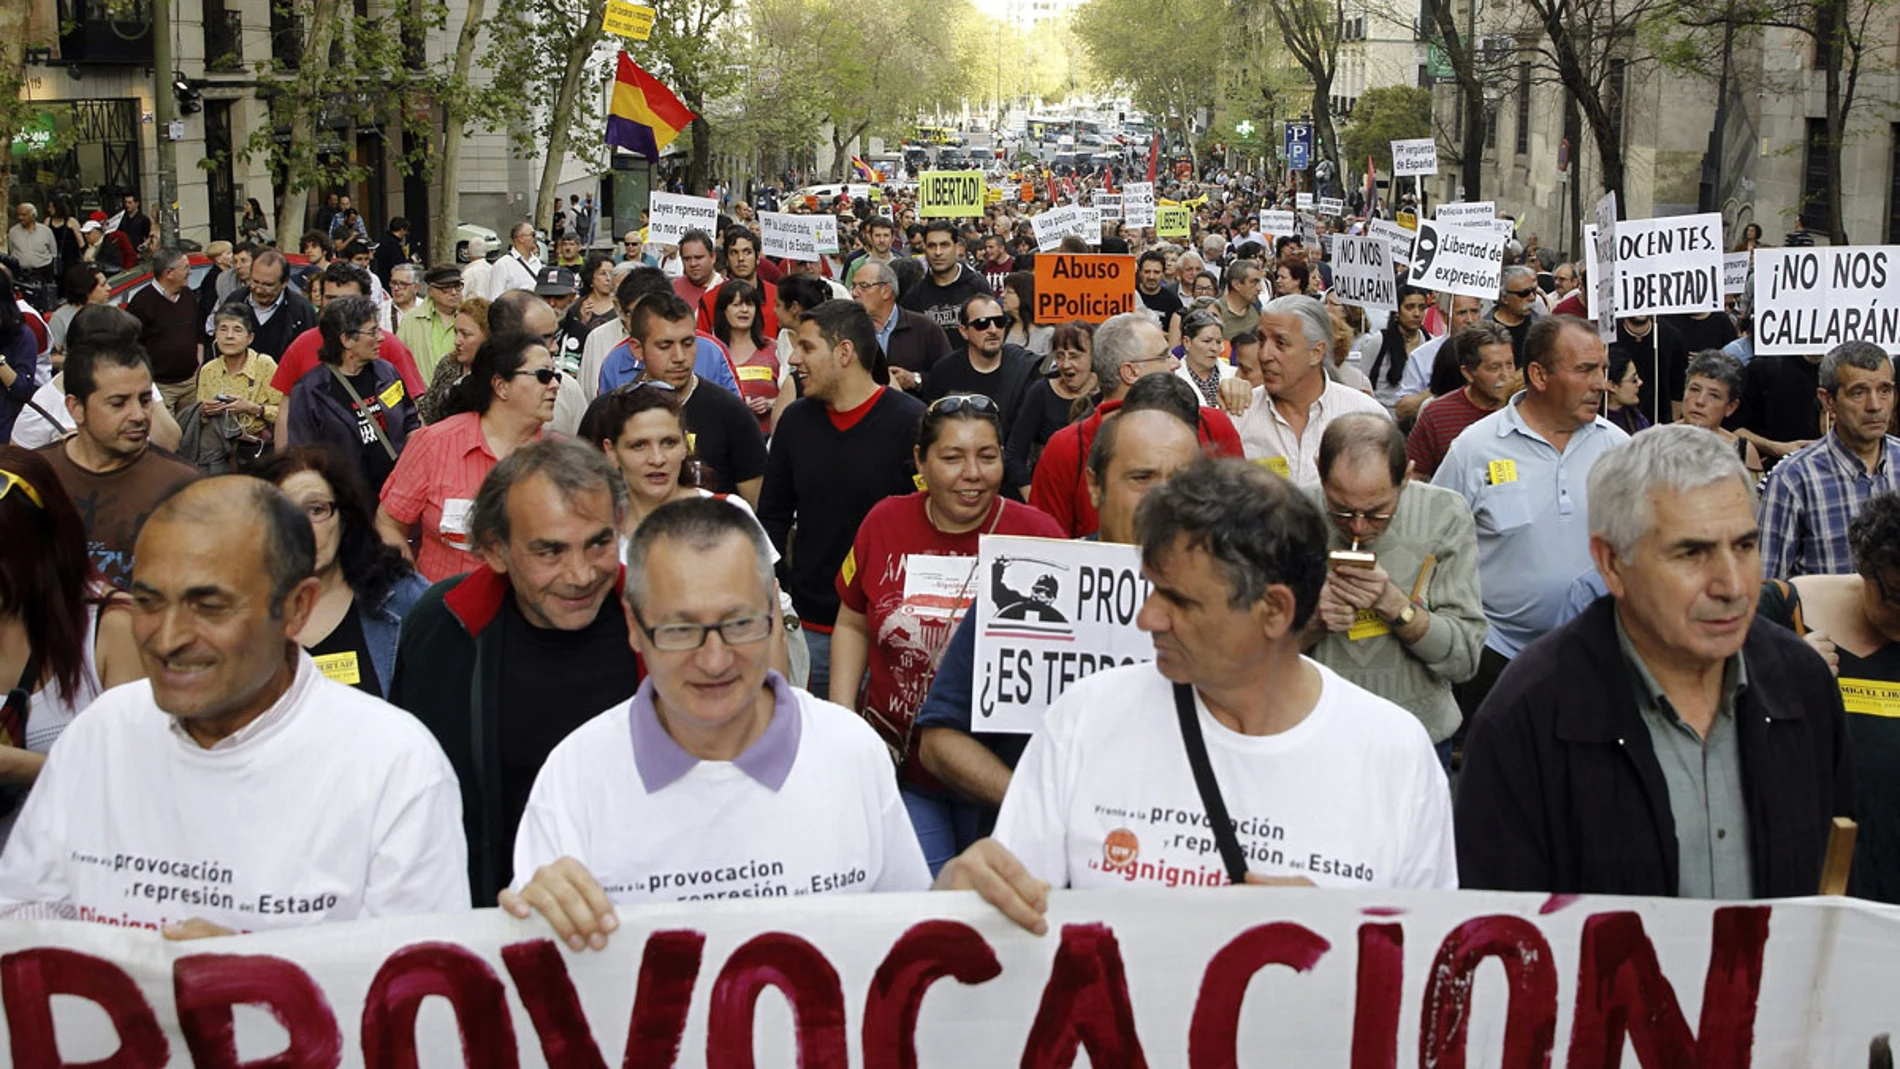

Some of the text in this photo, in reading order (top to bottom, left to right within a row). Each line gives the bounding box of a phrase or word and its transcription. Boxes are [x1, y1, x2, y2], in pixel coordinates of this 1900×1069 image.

[1292, 127, 1307, 141] P
[1293, 146, 1304, 157] P
[1397, 160, 1404, 169] de
[920, 177, 980, 210] ¡LIBERTAD!
[653, 200, 716, 219] Leyes represoras
[1465, 206, 1492, 214] secreta
[652, 223, 662, 232] no
[664, 224, 677, 234] nos
[1360, 241, 1382, 266] NOS
[1439, 234, 1502, 261] ¡Libertad de
[1053, 257, 1119, 280] Abuso
[1435, 266, 1499, 289] expresión!
[1771, 252, 1887, 299] ¡NO NOS
[1039, 291, 1134, 316] PPolicial!
[1760, 299, 1899, 345] CALLARÁN
[980, 648, 1033, 718] ¿ES
[1095, 805, 1126, 817] Frente
[1137, 810, 1146, 820] la
[115, 853, 233, 884] provocación
[811, 867, 866, 893] Estado
[1289, 859, 1304, 869] del
[1309, 854, 1374, 882] Estado
[132, 881, 234, 910] represión
[259, 893, 337, 914] Estado
